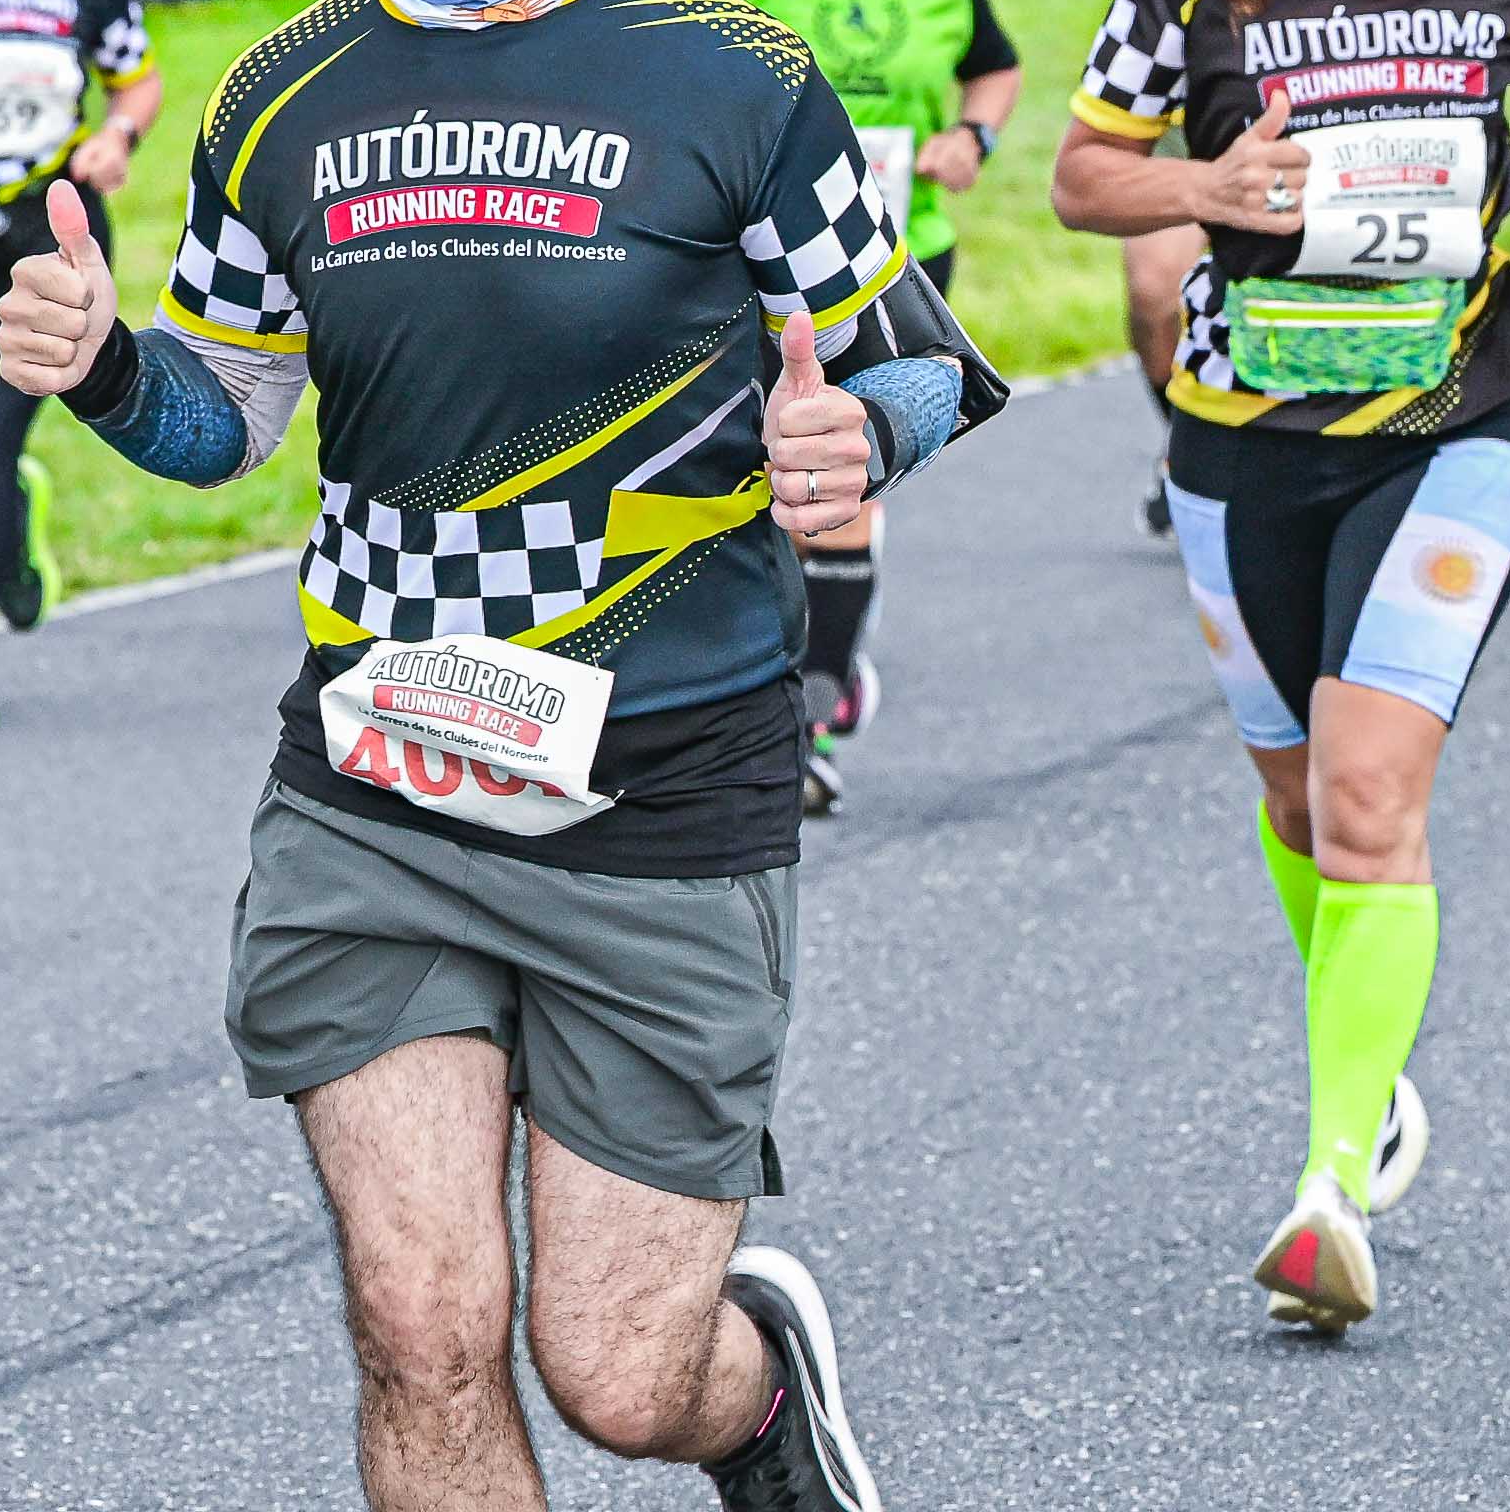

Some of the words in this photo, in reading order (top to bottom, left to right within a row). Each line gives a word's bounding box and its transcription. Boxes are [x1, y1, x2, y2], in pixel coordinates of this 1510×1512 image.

[1244, 4, 1506, 75] AUTÓDROMO
[1285, 62, 1397, 103] RUNNING
[1404, 62, 1470, 94] RACE
[313, 110, 630, 201] AUTÓDROMO
[349, 188, 476, 234] RUNNING
[484, 189, 566, 228] RACE
[311, 255, 325, 273] La
[325, 247, 381, 268] Carrera
[383, 241, 407, 260] de
[411, 239, 438, 258] los
[441, 238, 500, 257] Clubes
[502, 238, 532, 257] del
[537, 239, 627, 261] Noroeste
[1351, 213, 1429, 265] 25
[368, 645, 565, 724] AUTÓDROMO
[371, 710, 410, 728] Carrera
[411, 722, 425, 733] de
[427, 725, 442, 738] los
[444, 730, 479, 748] Clubes
[481, 742, 498, 753] del
[501, 746, 549, 763] Noroeste
[391, 690, 471, 723] RUNNING
[474, 706, 524, 739] RACE
[338, 726, 568, 797] 40
